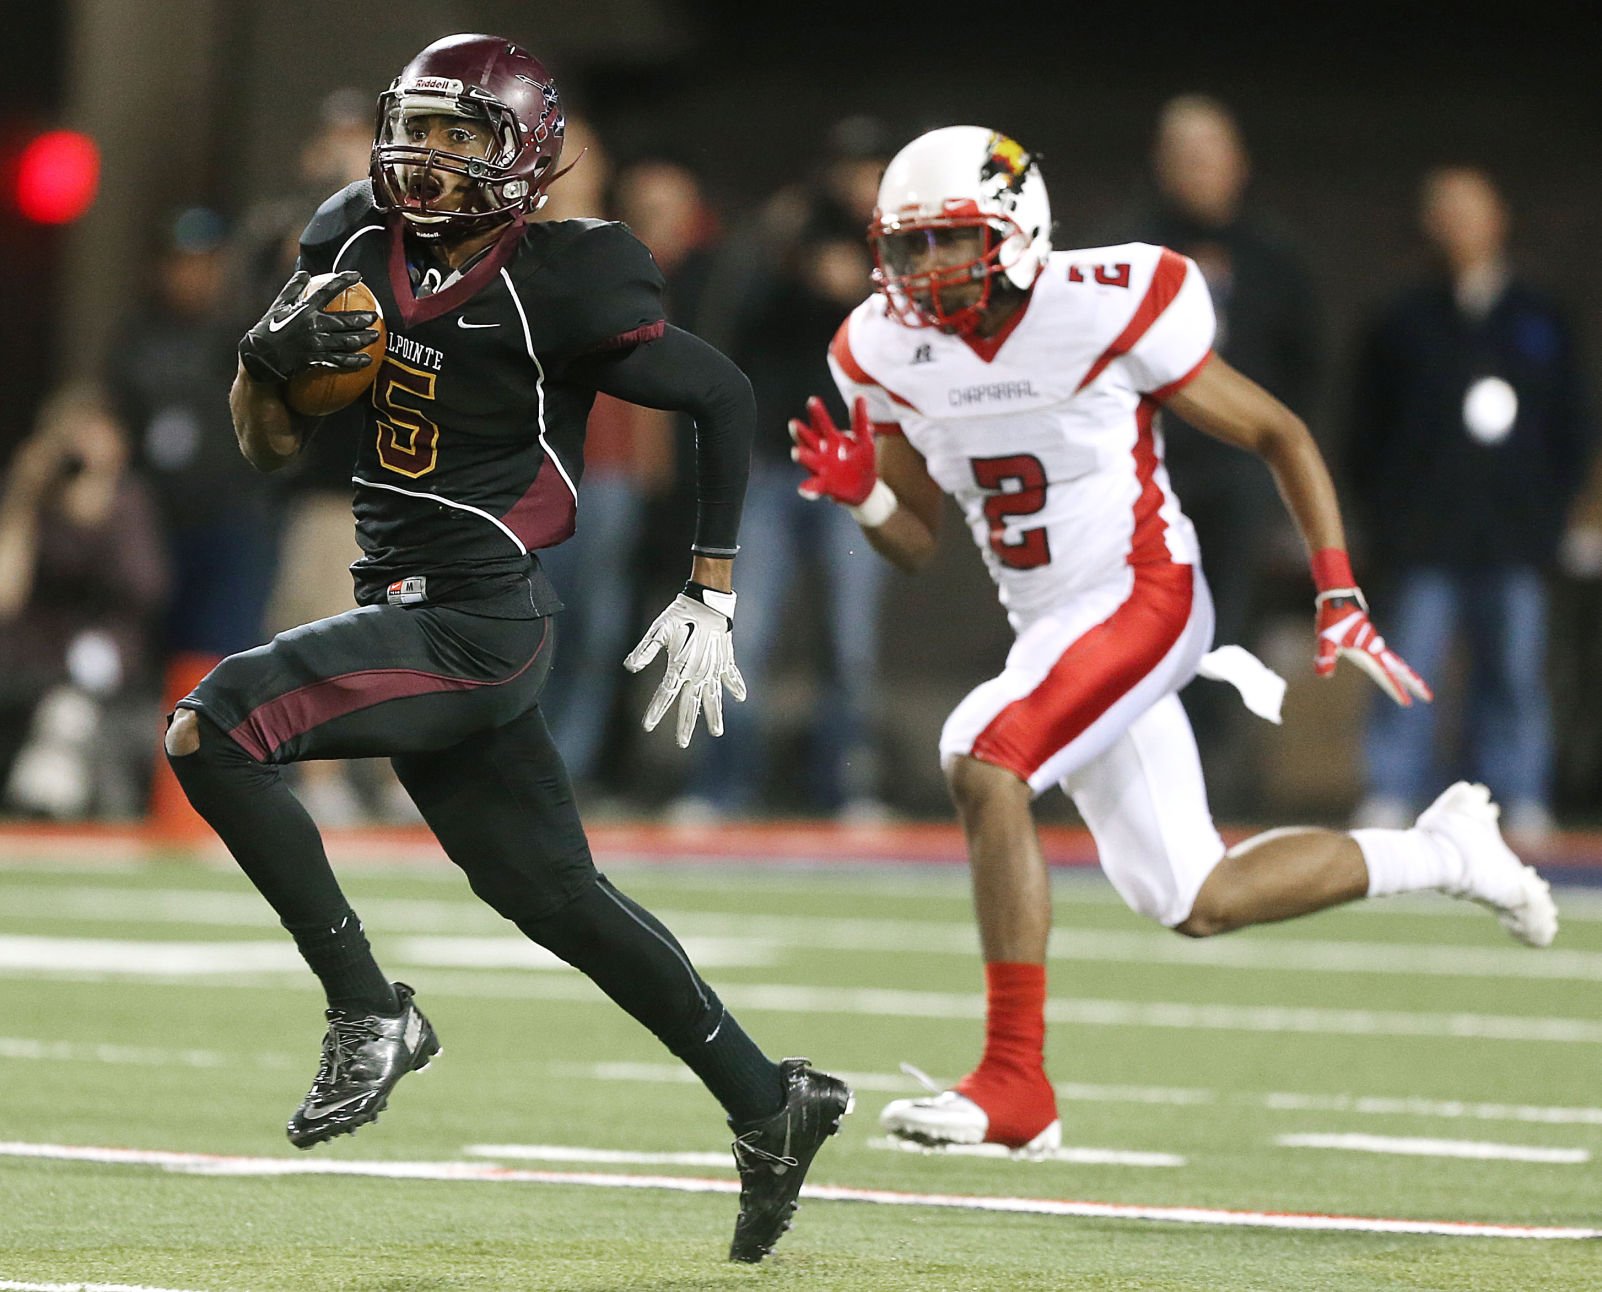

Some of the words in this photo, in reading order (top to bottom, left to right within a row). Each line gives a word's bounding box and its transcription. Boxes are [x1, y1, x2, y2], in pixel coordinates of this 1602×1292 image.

[415, 79, 450, 90] Riddell
[1068, 262, 1131, 290] 2
[385, 331, 444, 371] LPOINTE
[947, 379, 1041, 407] CHAPARRAL
[372, 356, 440, 480] 5
[969, 453, 1052, 571] 2
[405, 581, 414, 592] M
